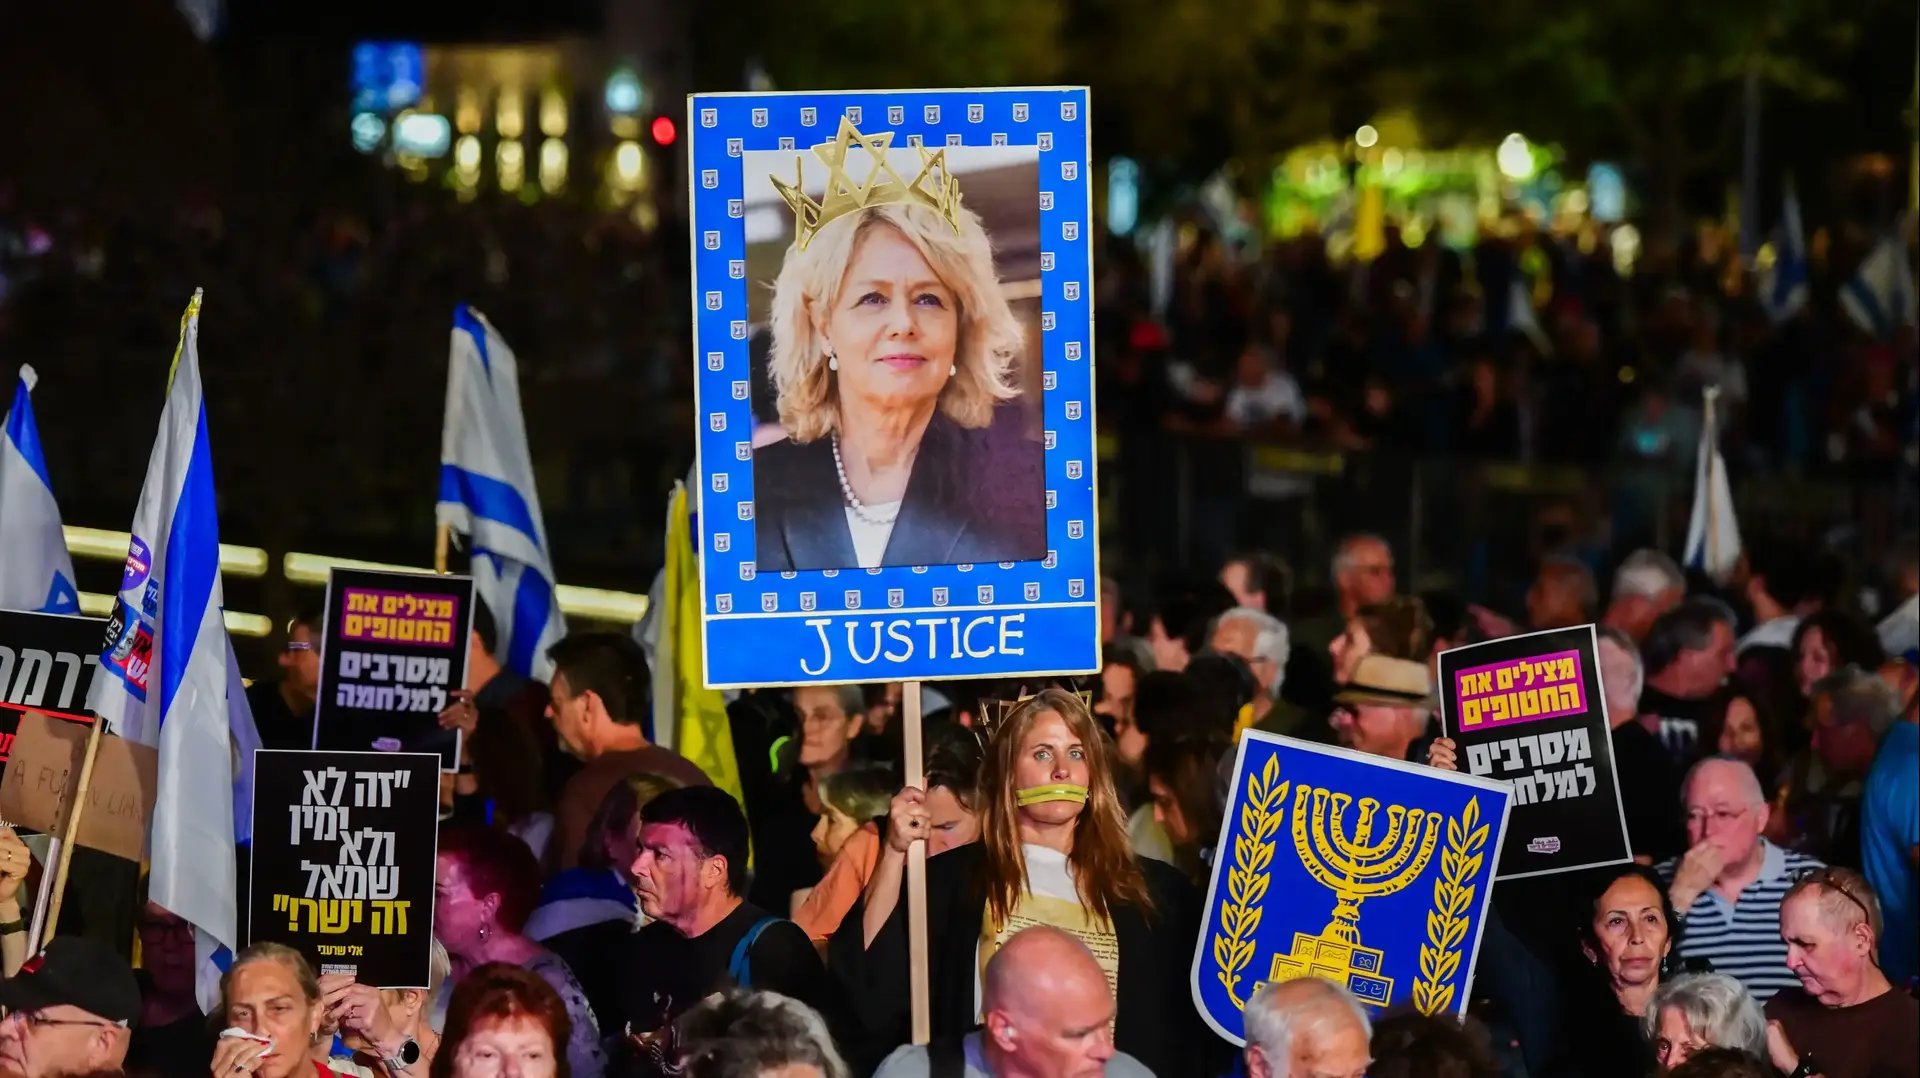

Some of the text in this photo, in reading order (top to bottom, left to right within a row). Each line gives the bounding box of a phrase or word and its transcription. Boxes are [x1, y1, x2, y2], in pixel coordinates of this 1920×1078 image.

[347, 593, 453, 619] מצילים את
[345, 614, 452, 643] החטופים
[800, 613, 1025, 676] JUSTICE
[339, 651, 450, 685] מסרבים
[1460, 657, 1577, 697] מצילים את
[336, 683, 447, 713] למלחמה
[1462, 683, 1581, 726] החטופים
[1465, 727, 1592, 776] מסרבים
[302, 766, 411, 807] "זה לא
[1508, 763, 1597, 807] למלח
[289, 804, 350, 845] ימין
[338, 827, 396, 866] ולא
[301, 860, 400, 900] שמאל
[272, 894, 411, 935] זה ישר!"
[317, 944, 364, 957] אלי שרעבי
